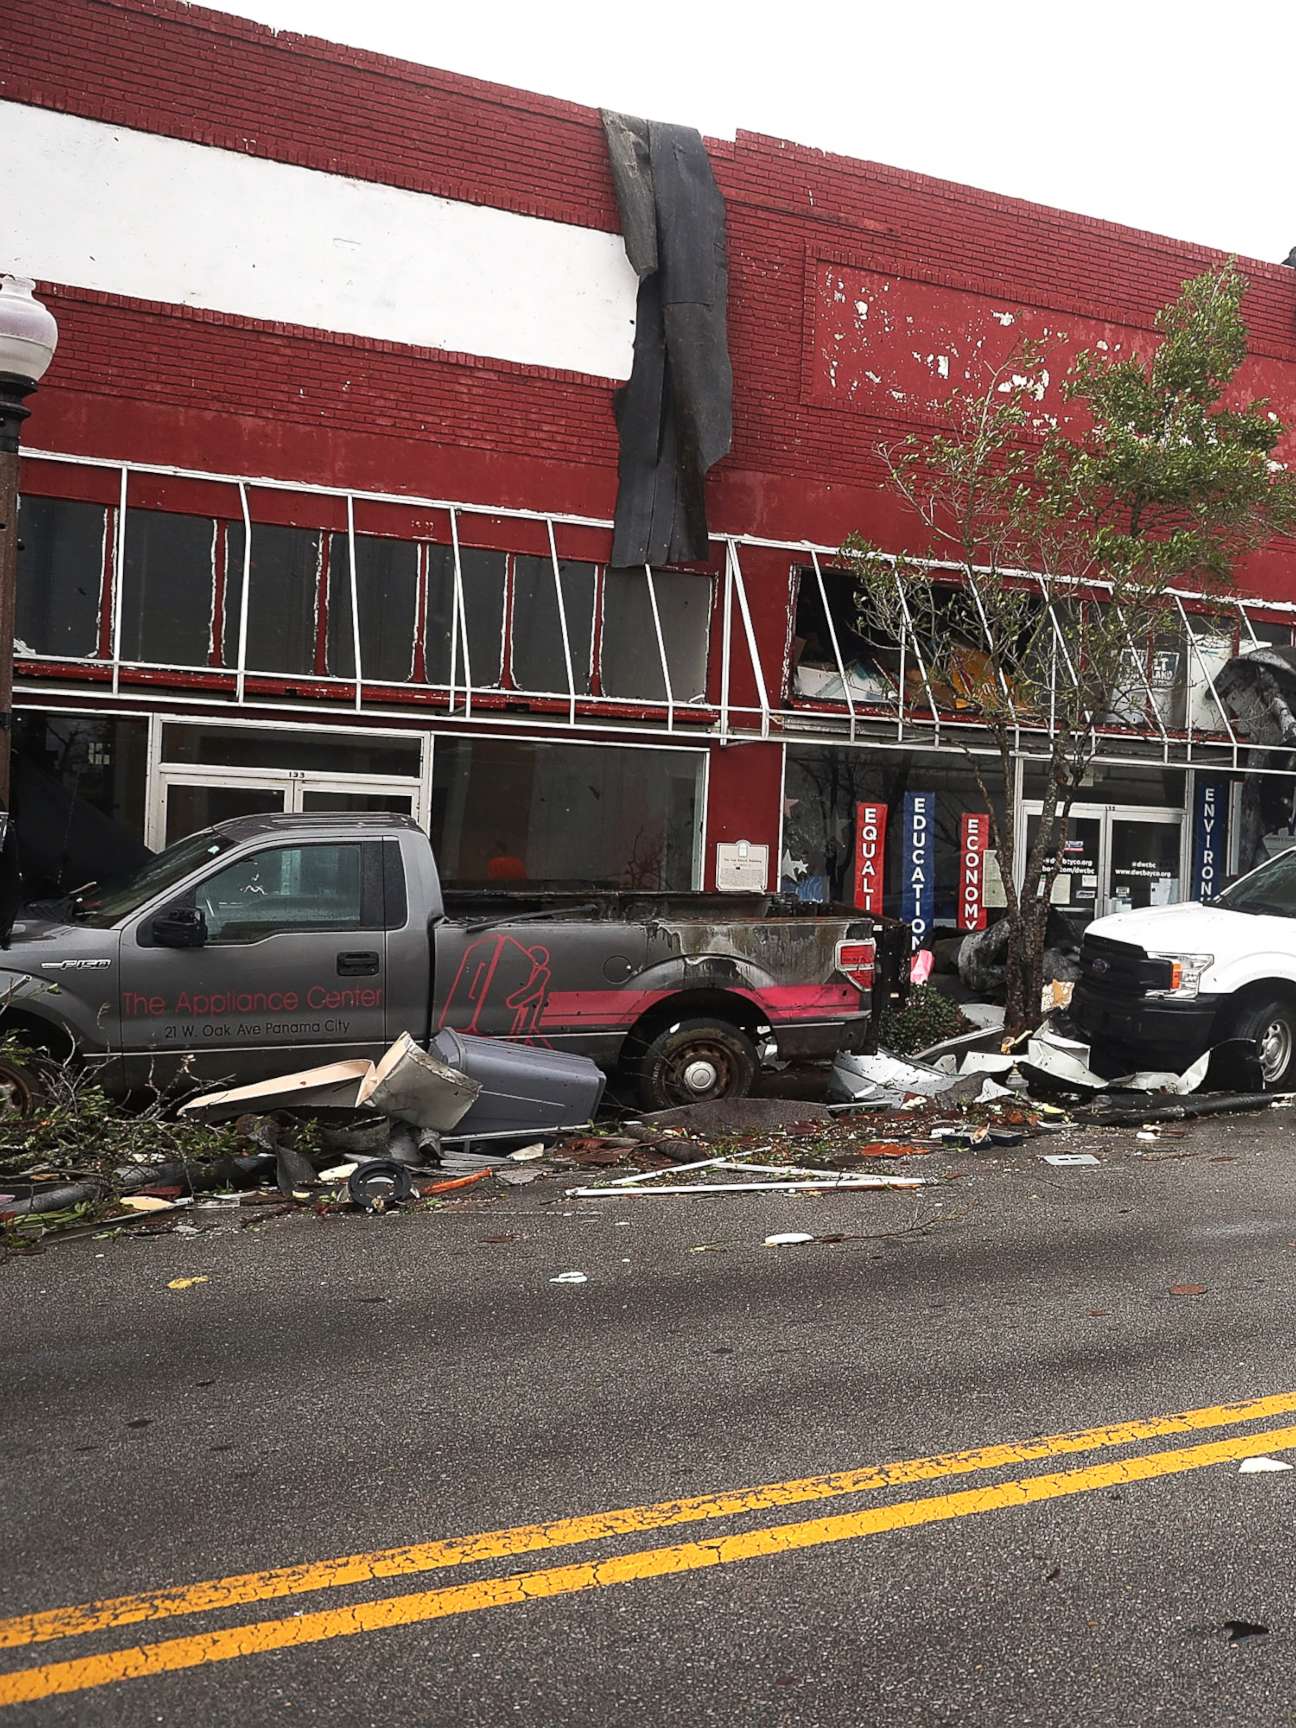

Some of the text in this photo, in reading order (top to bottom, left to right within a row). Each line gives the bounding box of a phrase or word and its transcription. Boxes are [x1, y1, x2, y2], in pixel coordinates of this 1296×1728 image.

[964, 818, 980, 930] ECONOMY
[1200, 788, 1216, 901] ENVIRON
[122, 985, 383, 1018] The Appliance Center
[164, 1019, 350, 1039] 21 W. Oak Ave Panama City
